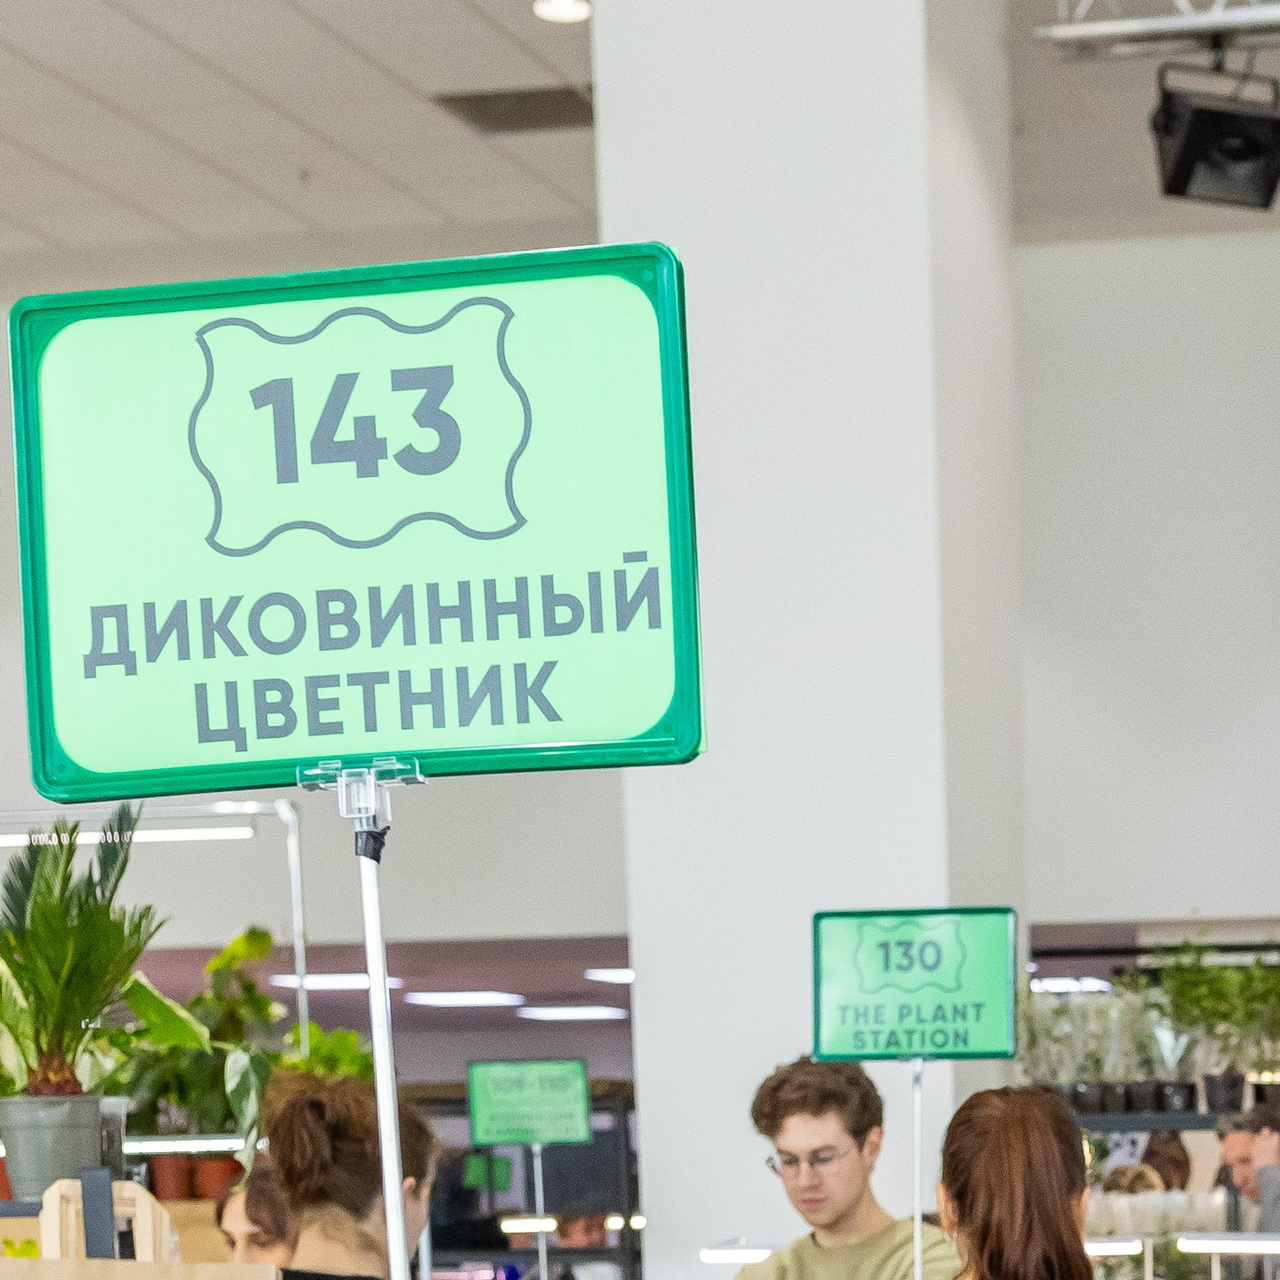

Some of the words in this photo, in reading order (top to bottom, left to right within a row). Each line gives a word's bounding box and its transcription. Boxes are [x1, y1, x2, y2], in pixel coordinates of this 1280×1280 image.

[249, 365, 462, 484] 143
[83, 551, 662, 678] ДИКОВИННЫЙ
[195, 661, 562, 752] ЦВЕТНИК
[877, 940, 942, 972] 130
[837, 1004, 885, 1025] THE
[898, 1003, 986, 1025] PLANT
[852, 1029, 969, 1050] STATION
